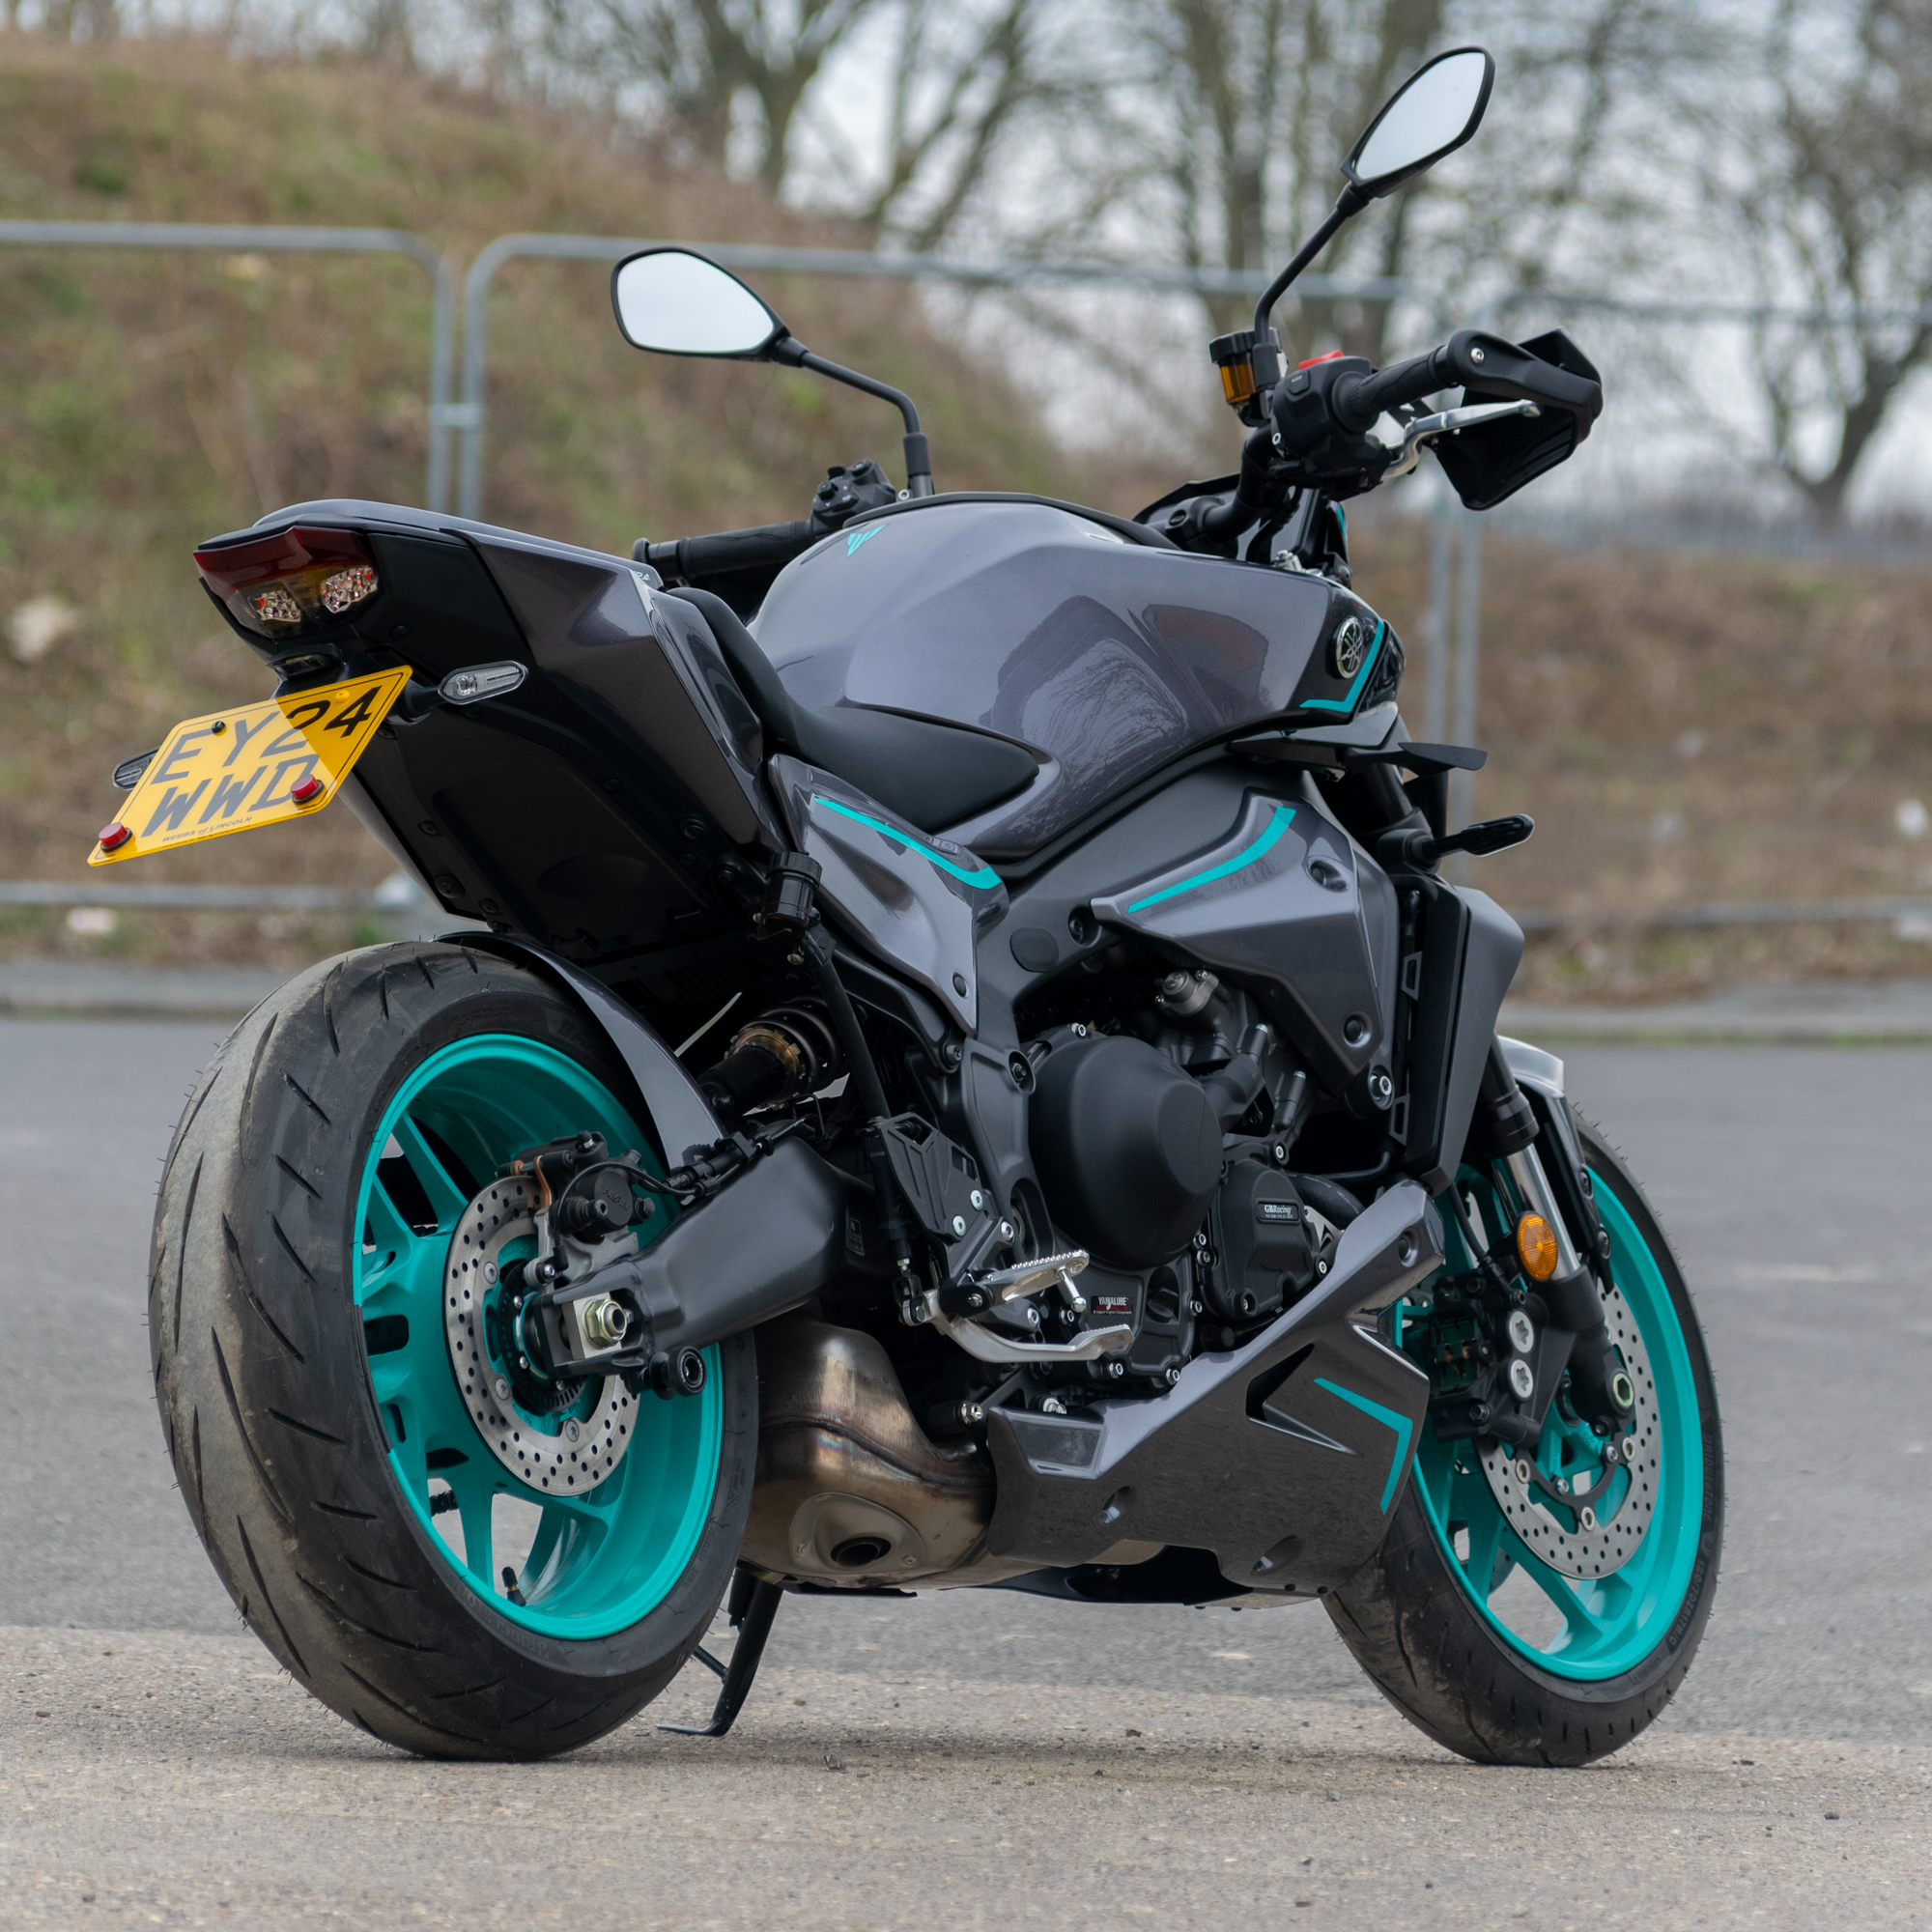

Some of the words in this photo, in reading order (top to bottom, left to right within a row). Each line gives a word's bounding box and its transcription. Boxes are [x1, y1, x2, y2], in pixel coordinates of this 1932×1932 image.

[150, 685, 383, 785] EY24
[140, 753, 320, 838] WWD
[162, 830, 196, 842] WEBBS
[209, 816, 252, 832] LINCOLN
[1097, 1295, 1128, 1306] YAMALUBE
